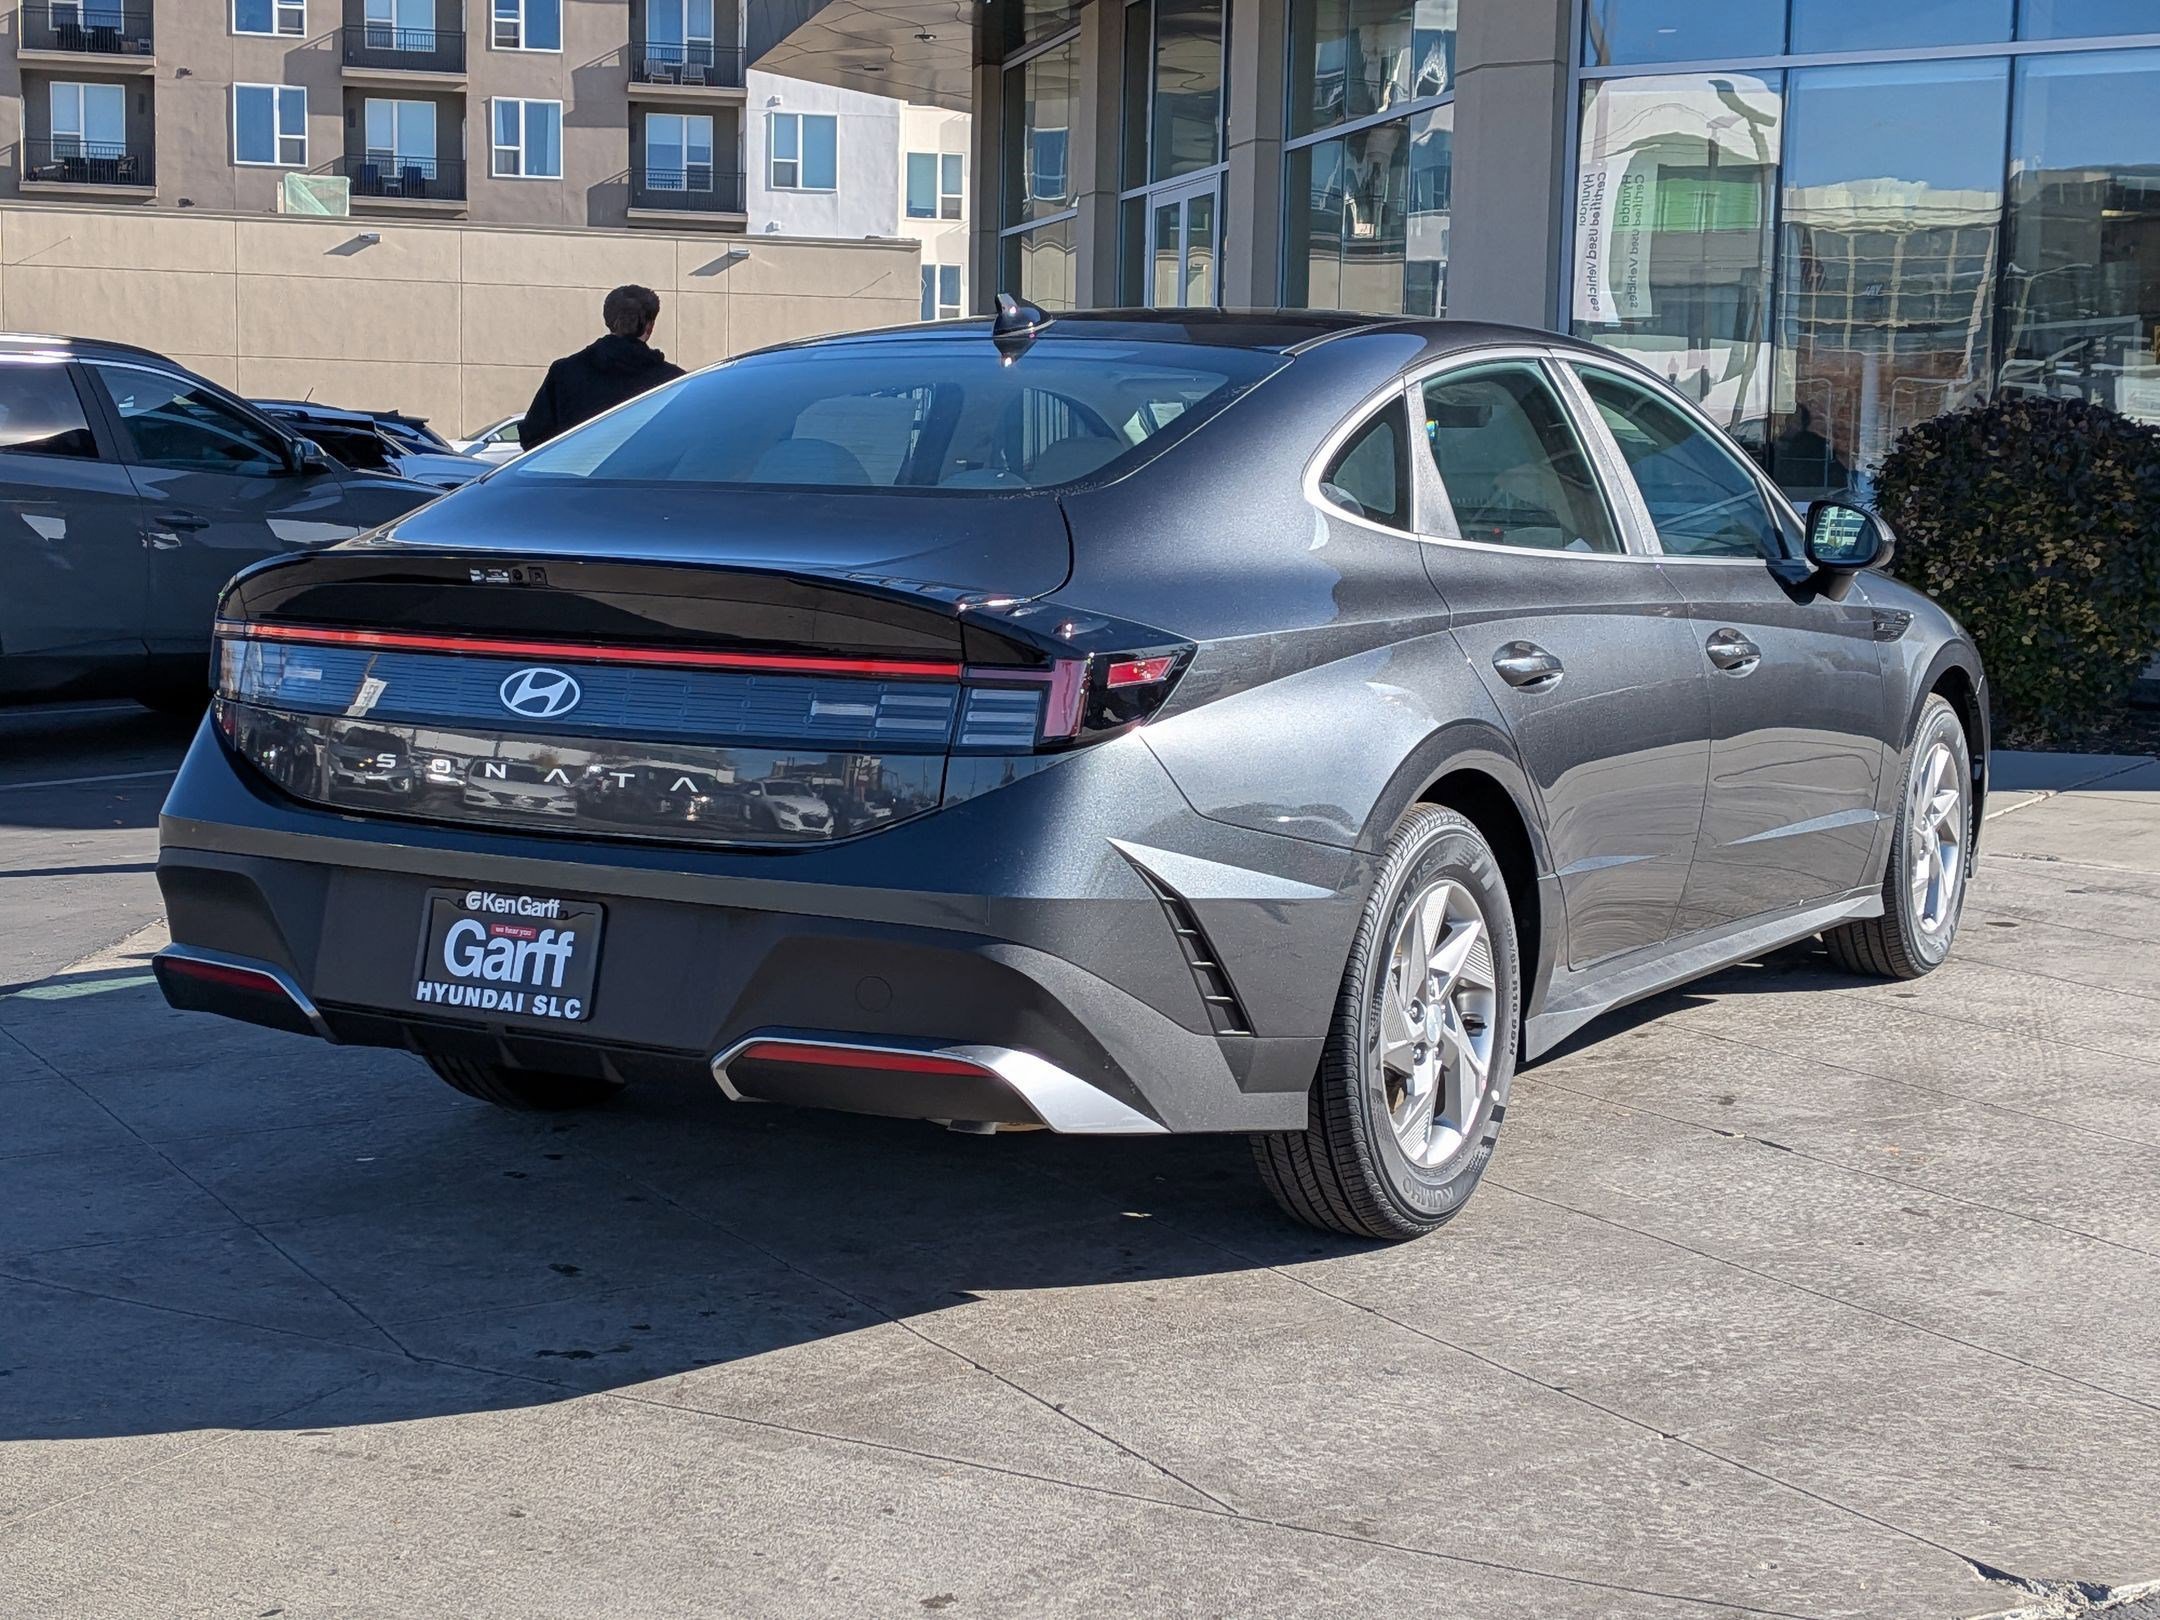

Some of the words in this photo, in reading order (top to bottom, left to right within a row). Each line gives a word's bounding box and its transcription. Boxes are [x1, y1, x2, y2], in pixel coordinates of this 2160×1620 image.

[376, 753, 699, 793] SONATA
[443, 918, 576, 988] Garff
[416, 981, 524, 1013] HYUNDAI
[532, 995, 581, 1020] SLC
